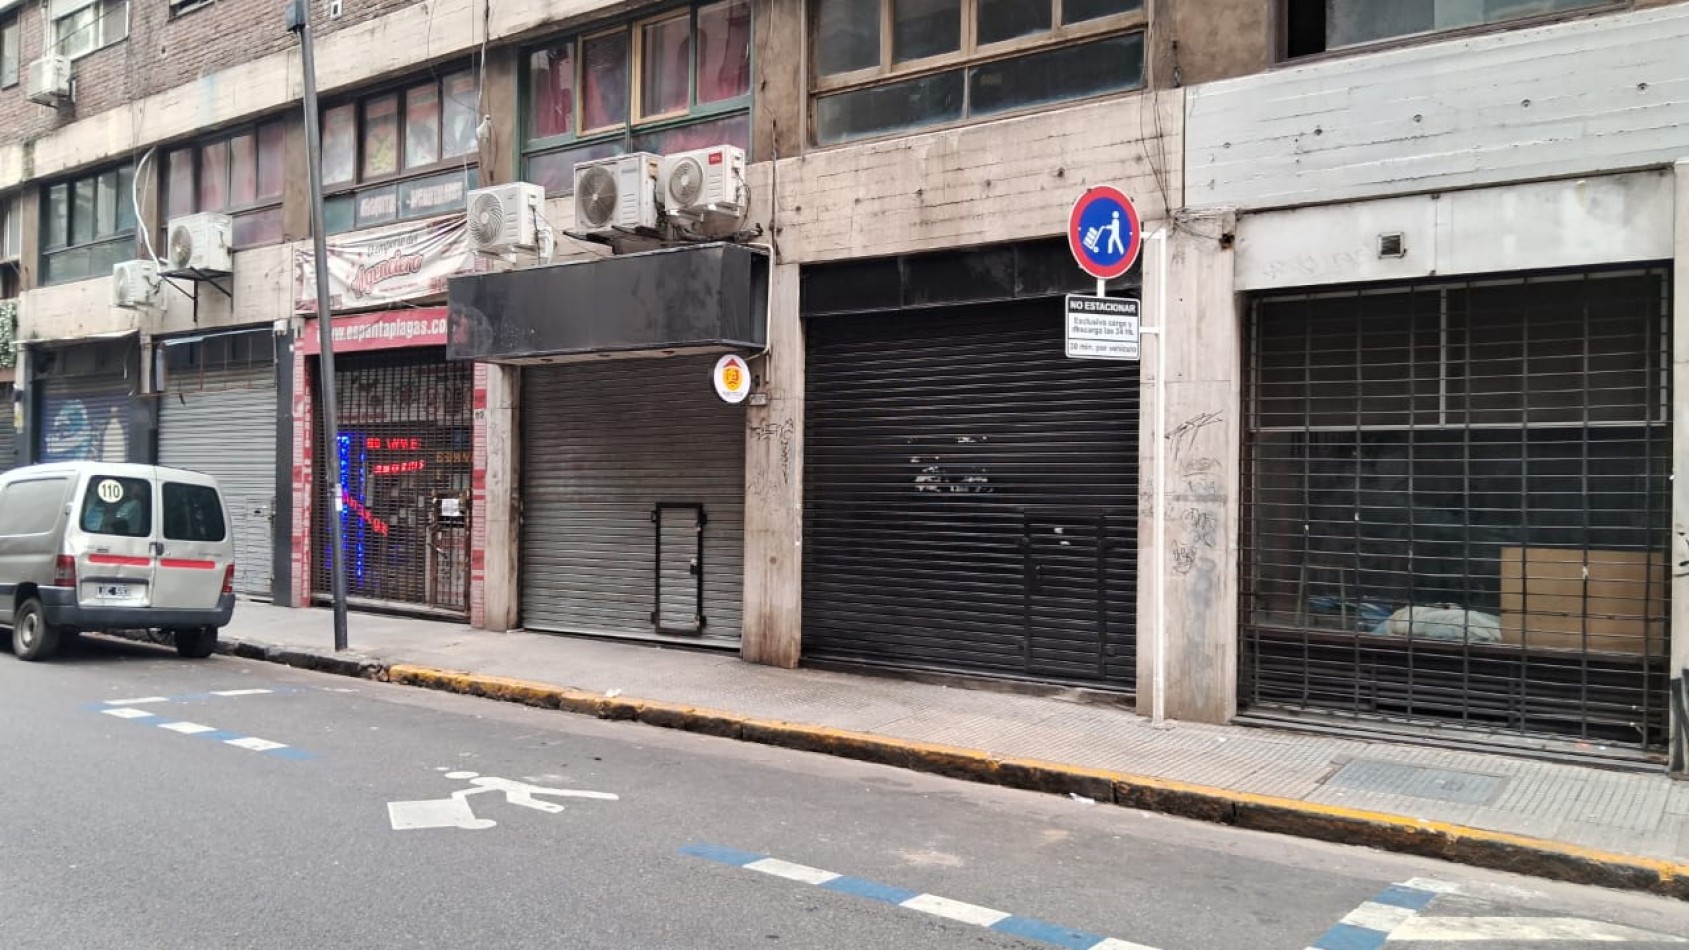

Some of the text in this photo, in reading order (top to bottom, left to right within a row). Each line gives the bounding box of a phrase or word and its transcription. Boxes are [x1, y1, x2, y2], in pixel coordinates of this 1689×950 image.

[351, 250, 424, 298] Agenciero
[1070, 300, 1136, 313] NO ESTACIONAR
[102, 483, 120, 498] 110
